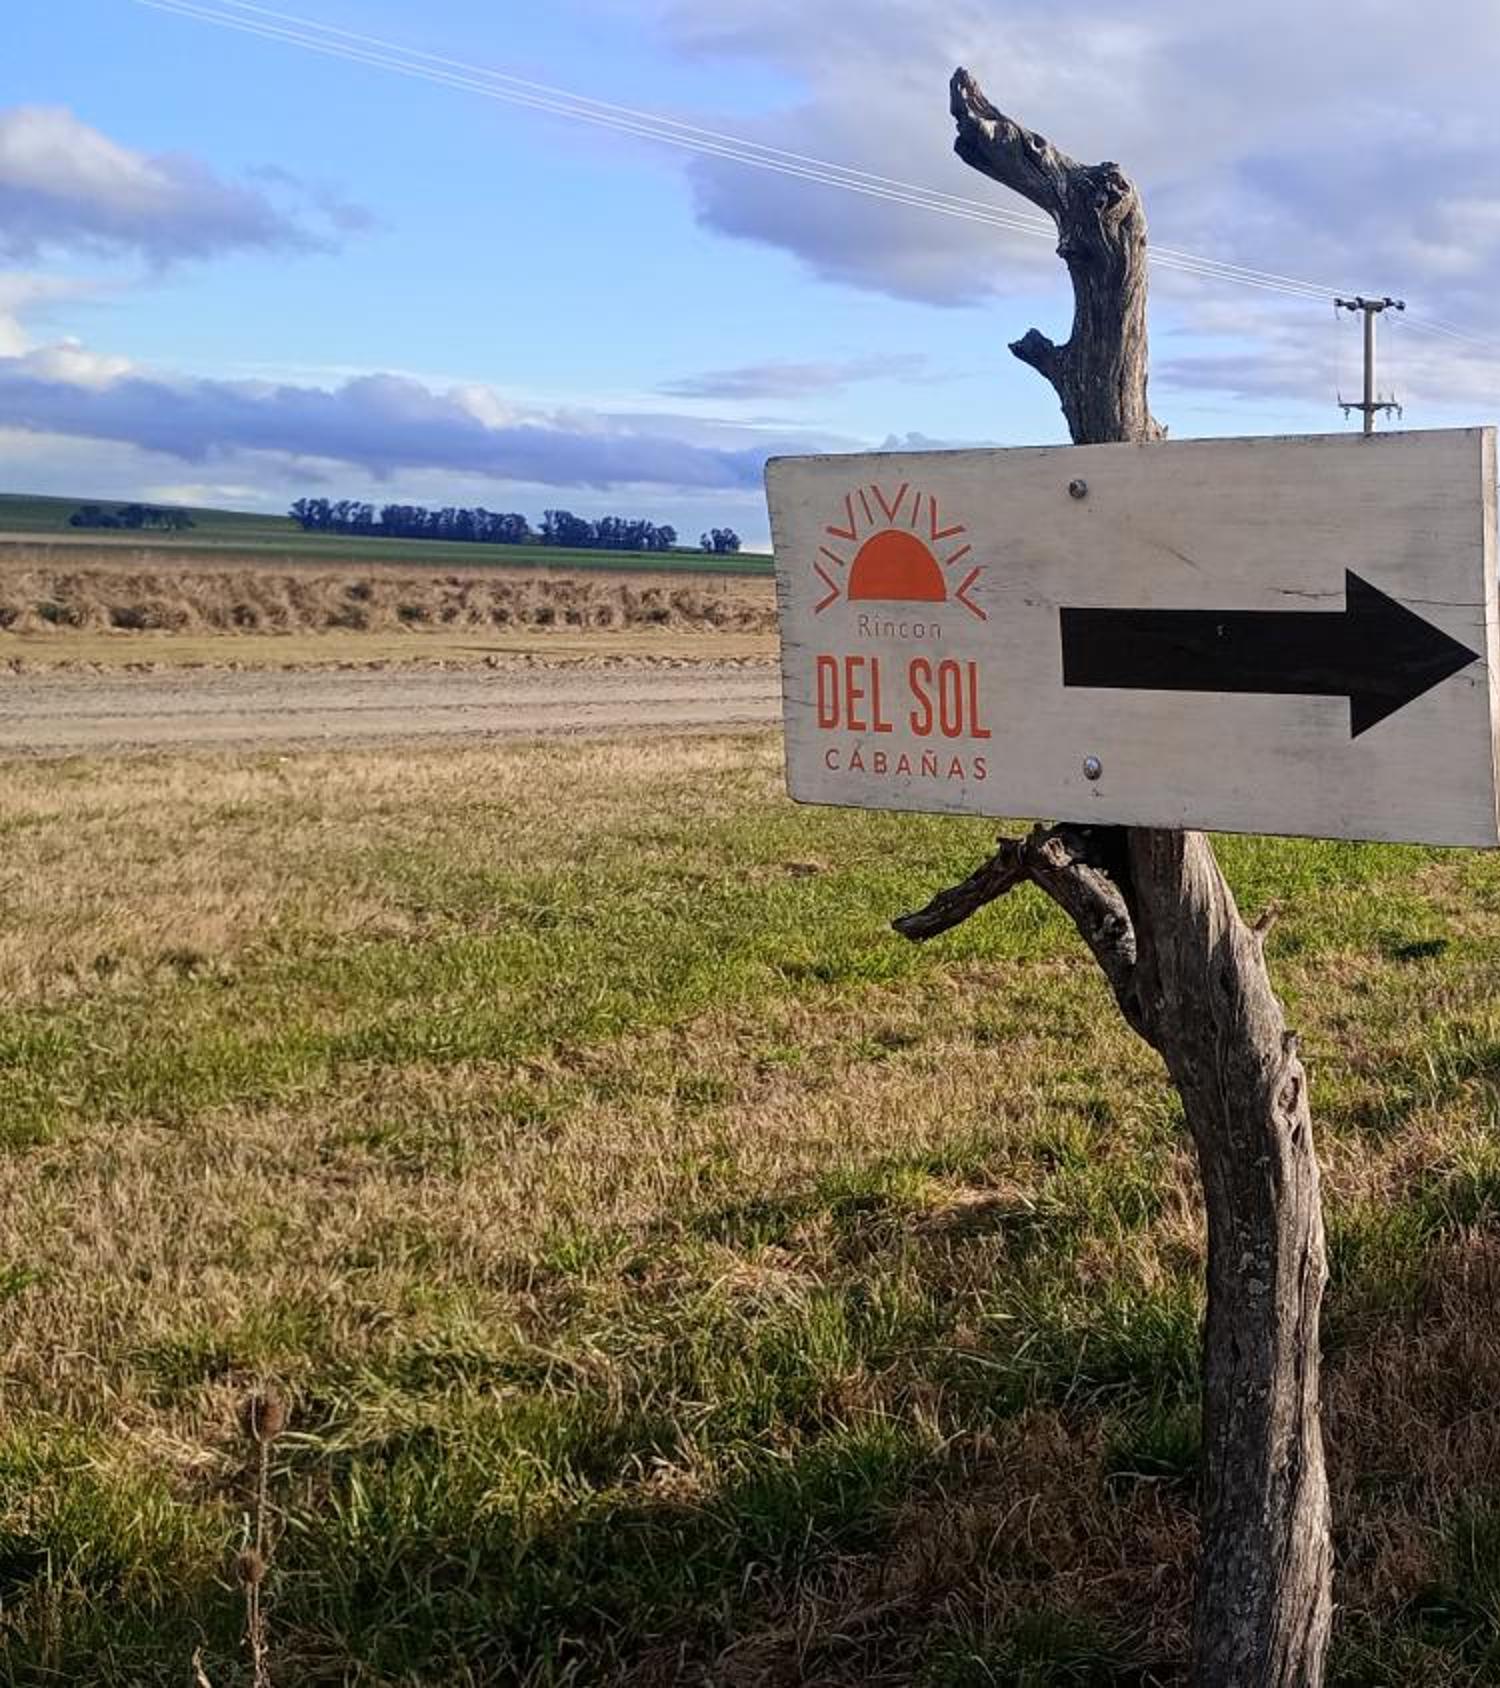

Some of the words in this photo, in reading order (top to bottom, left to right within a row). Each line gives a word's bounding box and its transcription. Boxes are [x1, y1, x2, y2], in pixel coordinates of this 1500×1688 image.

[858, 614, 942, 639] Rincon
[816, 656, 892, 732] DEL
[909, 658, 992, 738] SOL
